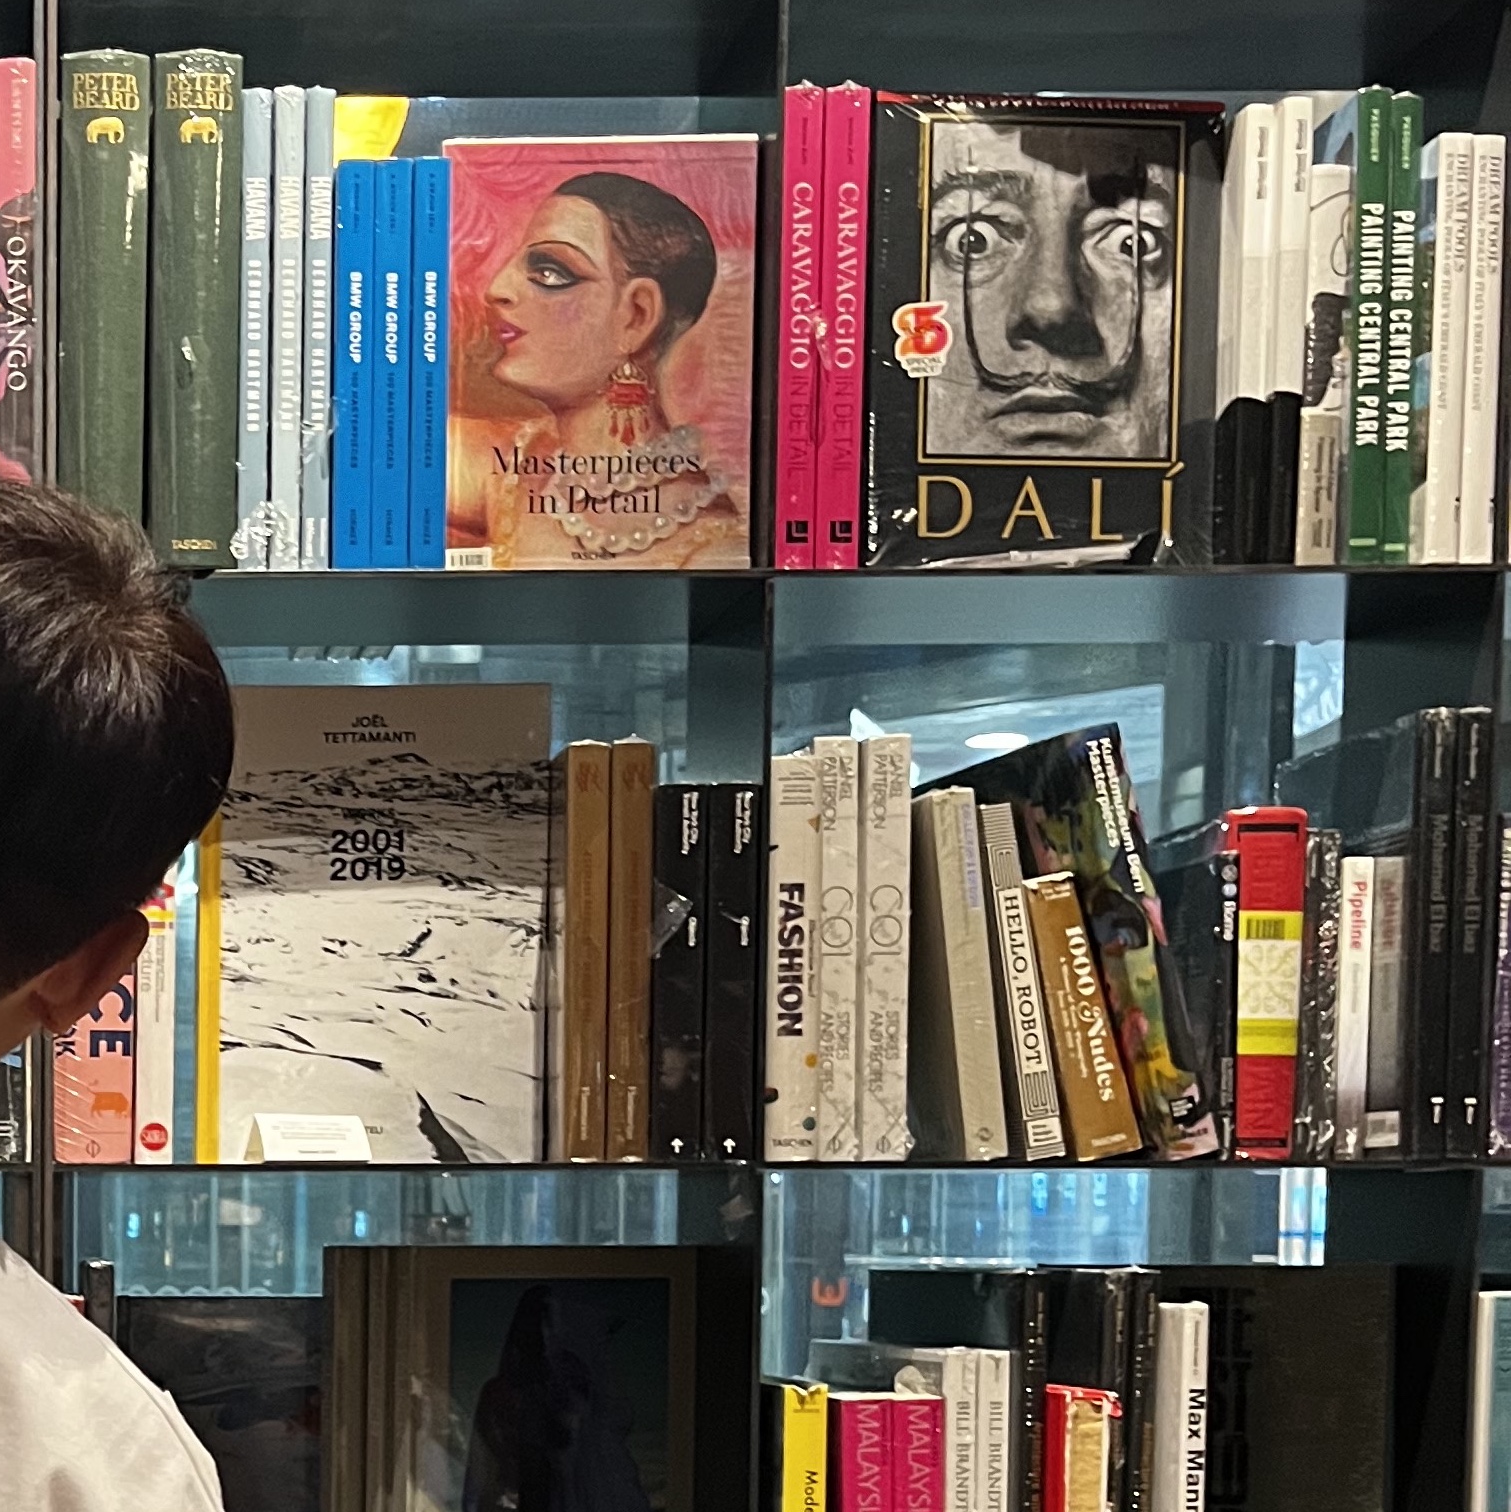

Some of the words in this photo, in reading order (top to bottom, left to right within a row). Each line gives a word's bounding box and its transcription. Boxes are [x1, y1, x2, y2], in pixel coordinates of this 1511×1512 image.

[72, 73, 138, 92] PETER
[72, 91, 140, 111] BEARD
[245, 177, 266, 239] HAVANA
[790, 182, 815, 368] CARAVAGGIO
[1362, 203, 1385, 298] PAINTING
[1391, 210, 1415, 302] PAINTING
[349, 271, 362, 308] BMW
[385, 271, 399, 308] BMW
[349, 311, 362, 364] GROUP
[385, 311, 399, 364] GROUP
[1357, 301, 1382, 389] CENTRAL
[1387, 308, 1413, 395] CENTRAL
[789, 376, 808, 396] IN
[1355, 394, 1378, 447] PARK
[1385, 401, 1409, 452] PARK
[491, 446, 701, 479] Masterpieces
[528, 489, 557, 514] in
[566, 486, 661, 515] Detail
[918, 461, 1185, 541] DALÍ
[323, 731, 416, 744] TETTAMANTI
[351, 714, 388, 728] JOËL
[873, 755, 888, 829] PATTERSON
[1098, 738, 1135, 853] Kunstmuseum
[1128, 853, 1148, 894] Bern
[332, 829, 404, 853] 2001
[330, 856, 405, 881] 2019
[1003, 894, 1029, 978] HELLO,
[1349, 881, 1367, 950] Pipeline
[777, 883, 804, 1037] FASHION
[1062, 924, 1094, 996] 1000
[1187, 1387, 1206, 1440] Max
